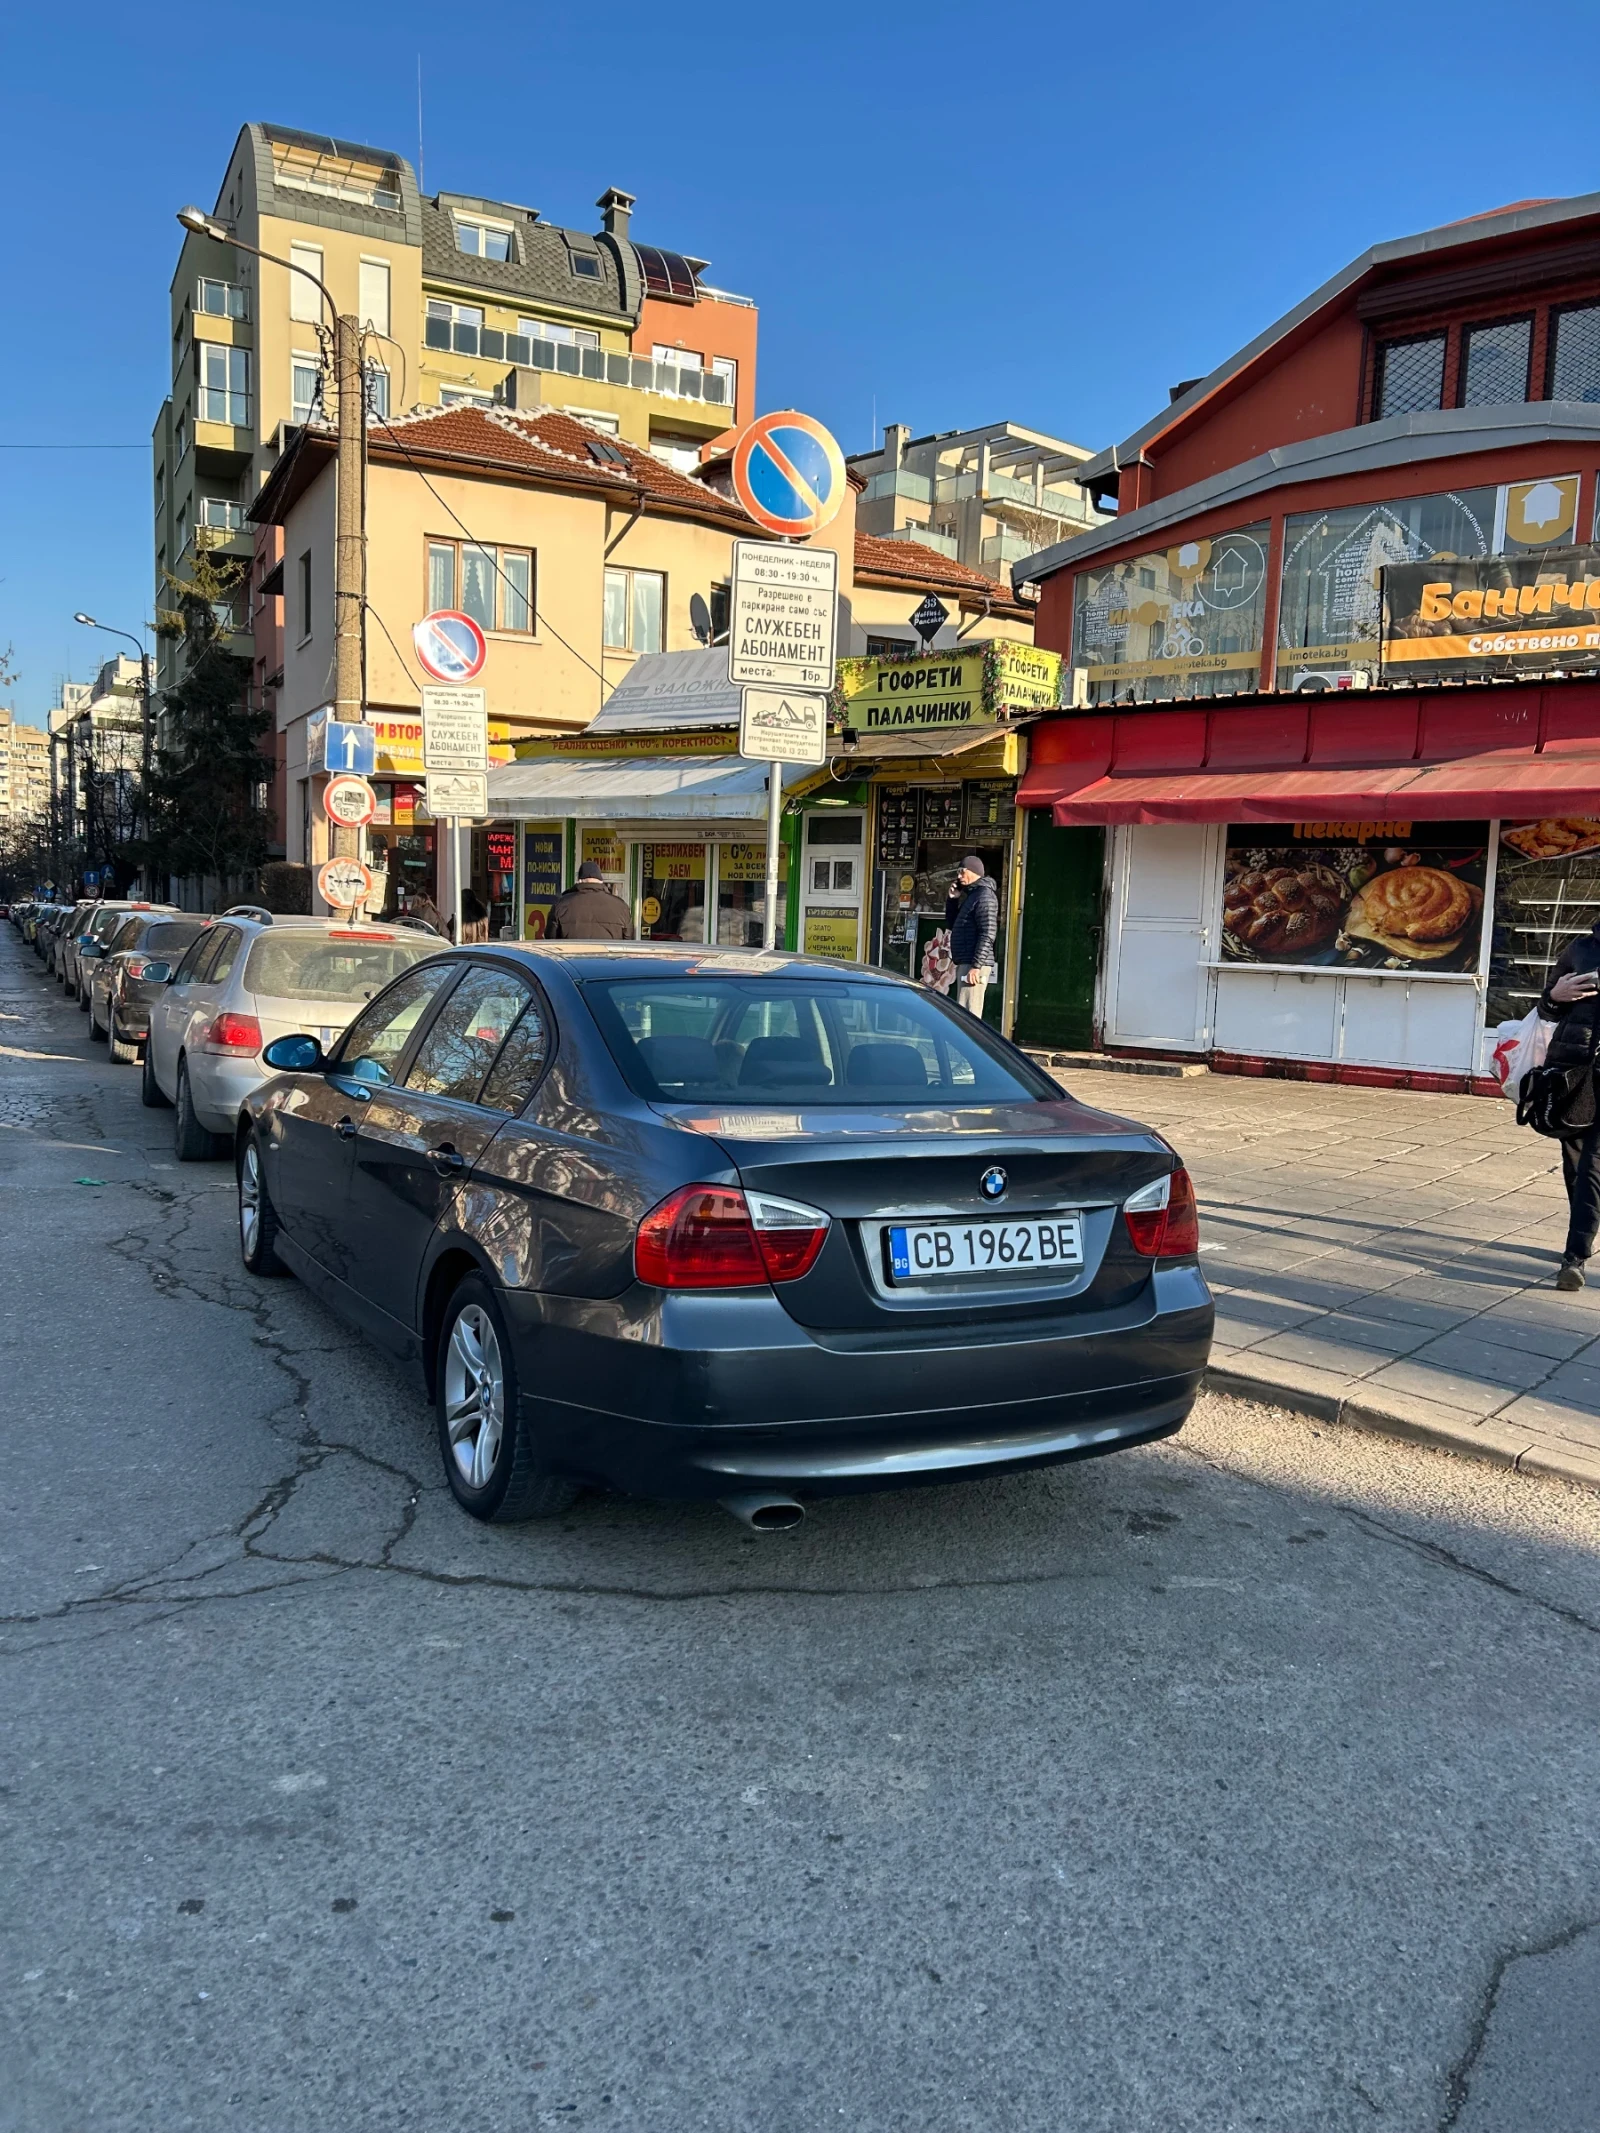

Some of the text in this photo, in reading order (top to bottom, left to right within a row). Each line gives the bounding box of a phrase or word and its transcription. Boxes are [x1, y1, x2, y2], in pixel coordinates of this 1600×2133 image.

[742, 552, 794, 565] ПОНЕДЕЛНИК
[800, 560, 831, 569] НЕДЕЛЯ
[754, 568, 779, 578] 08:30
[787, 572, 810, 581] 19:30
[758, 587, 812, 602] Разрешено е
[741, 600, 828, 617] паркиране само със
[924, 598, 937, 608] 33
[745, 617, 821, 640] СЛУЖЕБЕН
[914, 616, 945, 626] Pancakes
[740, 639, 826, 661] АБОНАМЕНТ
[1468, 633, 1579, 654] Собствено
[1290, 648, 1348, 661] imoteka.bg
[740, 666, 776, 677] места:
[1009, 657, 1049, 682] ГОФРЕТИ
[877, 664, 963, 692] ГОФРЕТИ
[1002, 681, 1052, 706] ПАЛАЧИНКИ
[867, 700, 972, 727] ПАЛАЧИНКИ
[431, 729, 478, 741] СЛУЖЕБЕН
[429, 741, 482, 753] АБОНАМЕНТ
[552, 736, 727, 751] РЕАЛНИ ОЦЕНКИ 100% КОРЕКТНОСТ
[1293, 821, 1413, 845] Пекарна
[535, 841, 553, 853] НОВИ
[655, 843, 706, 858] БЕЗЛИХВЕН
[730, 843, 753, 860] 0%
[527, 860, 561, 873] ПО-НИСКИ
[668, 863, 691, 878] ЗАЕМ
[733, 862, 767, 870] ЗА ВСЕК
[727, 870, 767, 880] НОВ КЛИЕ
[531, 883, 556, 895] ЛИХВИ
[963, 1227, 1034, 1265] 1962
[1038, 1224, 1078, 1261] BE
[894, 1258, 908, 1269] BG
